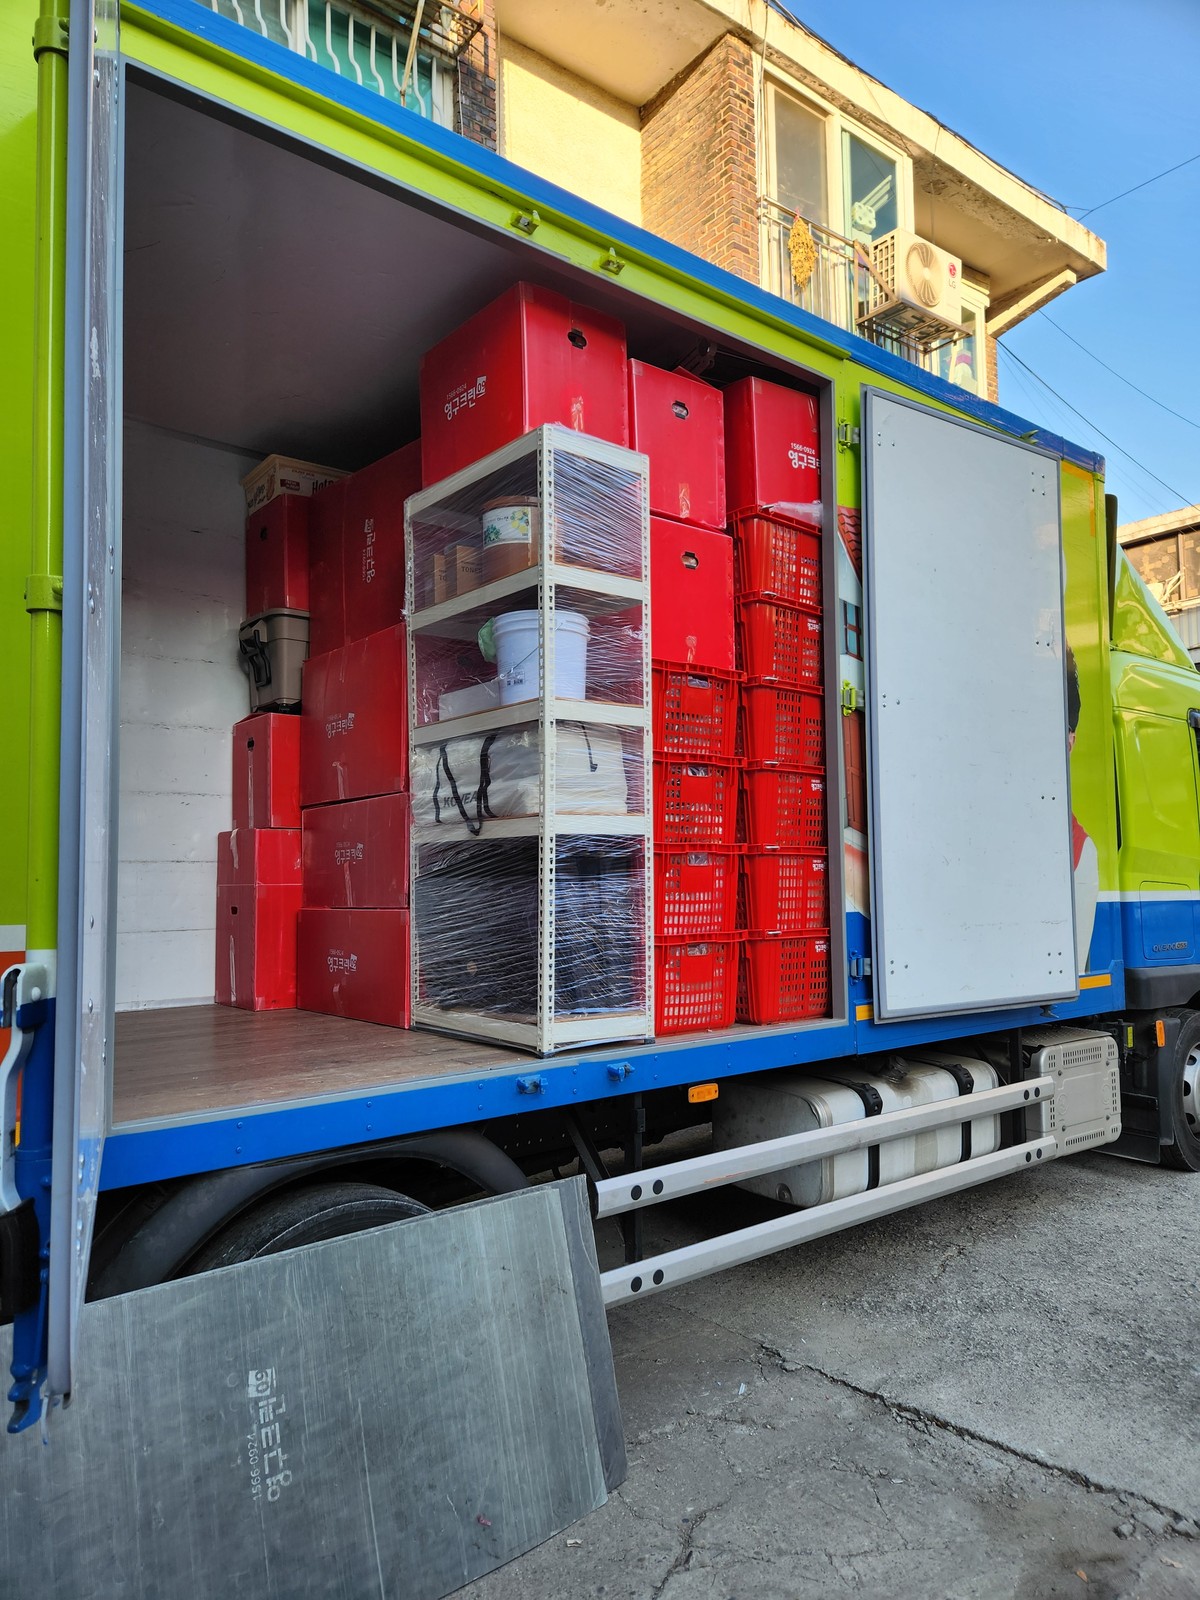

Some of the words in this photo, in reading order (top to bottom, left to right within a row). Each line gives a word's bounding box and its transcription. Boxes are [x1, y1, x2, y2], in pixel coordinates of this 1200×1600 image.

[948, 278, 957, 289] LG
[444, 387, 476, 421] 영구크린
[790, 442, 816, 455] 1566-0924
[366, 532, 375, 583] 영구크린
[326, 719, 348, 739] 영구크린
[327, 956, 350, 975] 영구크린
[258, 1393, 293, 1502] 영구크린
[247, 1431, 263, 1502] 1566-0924
